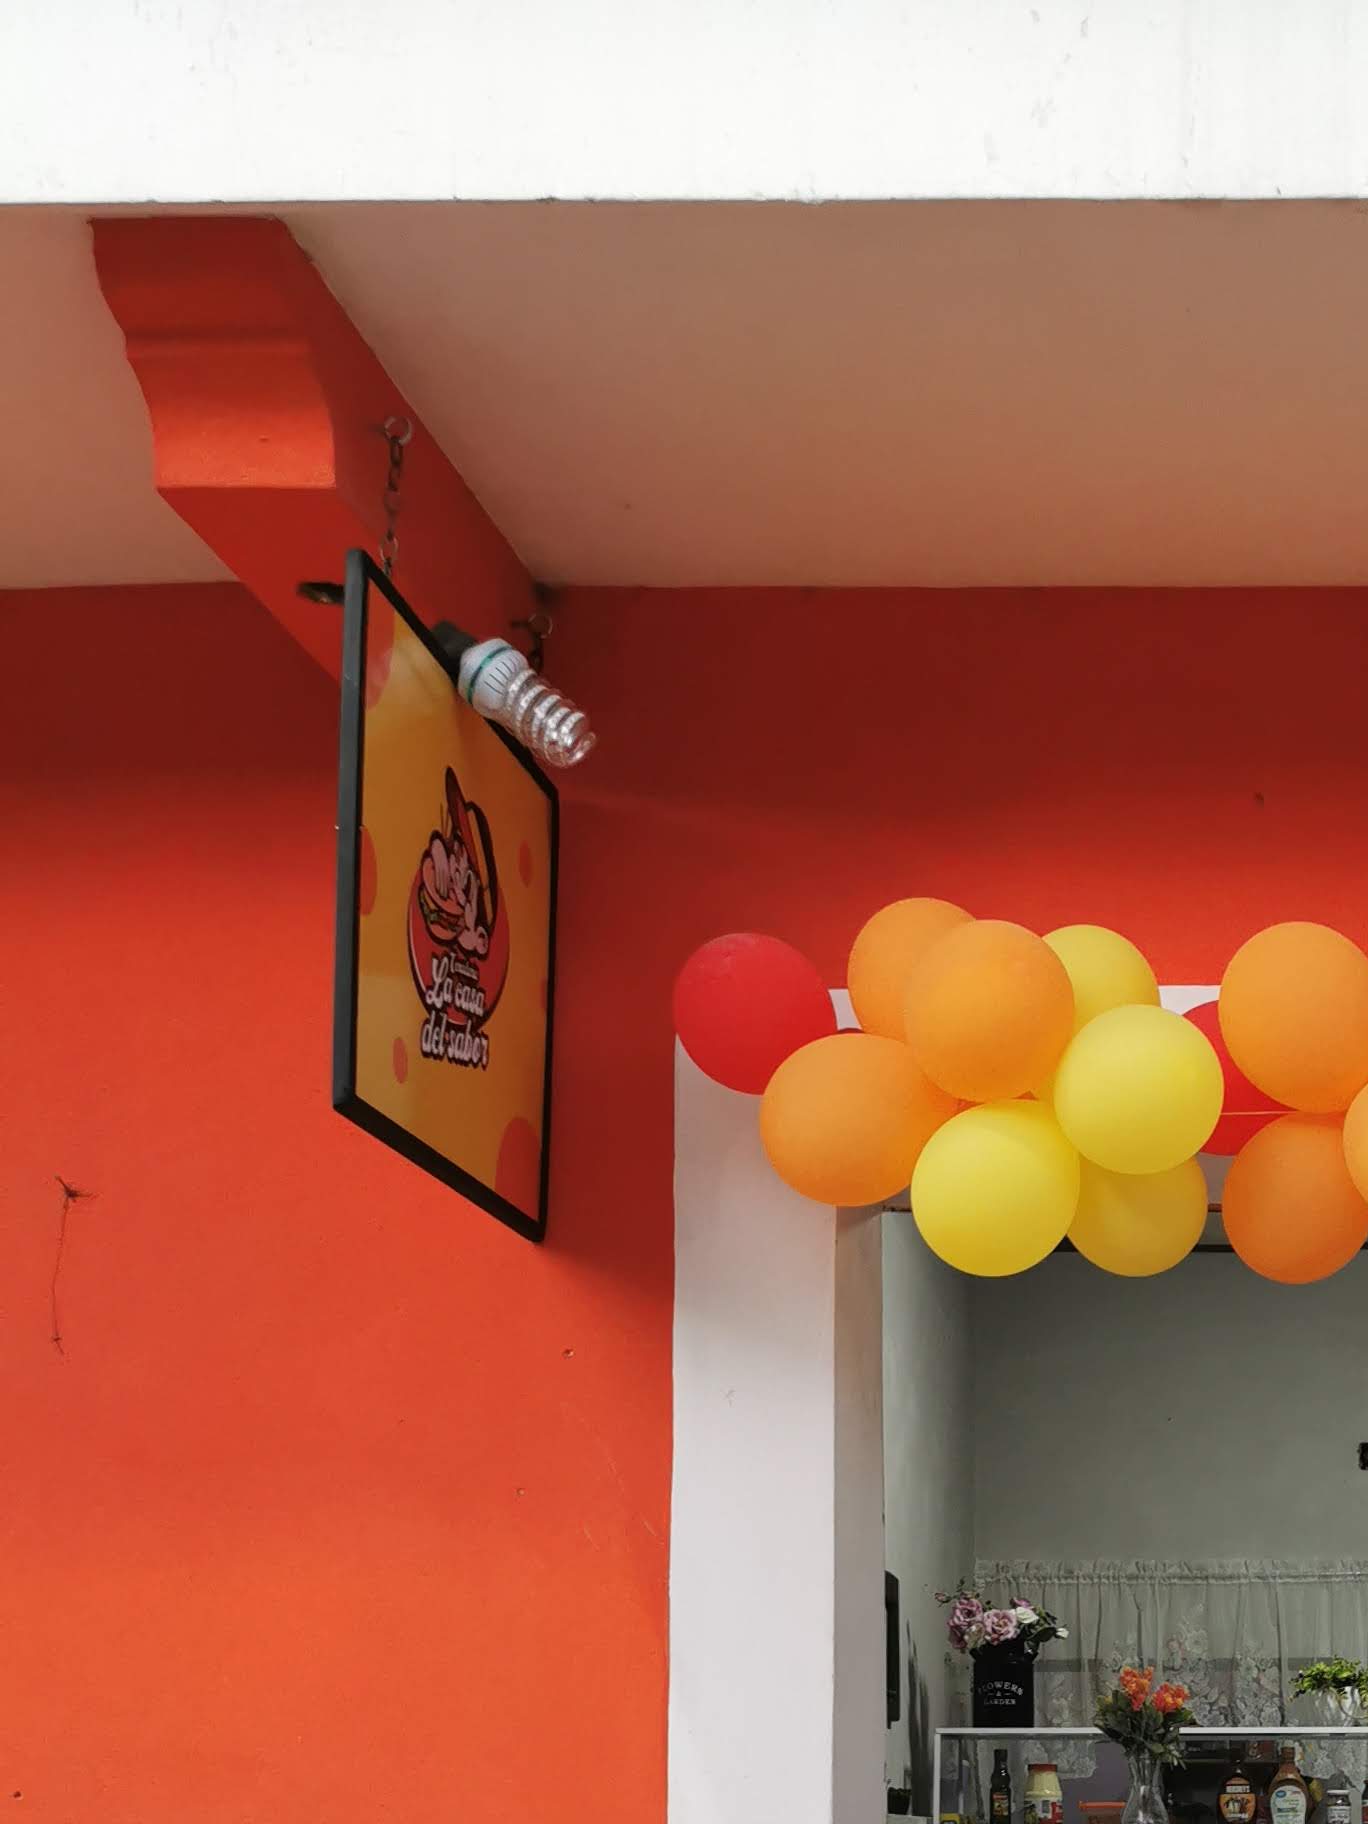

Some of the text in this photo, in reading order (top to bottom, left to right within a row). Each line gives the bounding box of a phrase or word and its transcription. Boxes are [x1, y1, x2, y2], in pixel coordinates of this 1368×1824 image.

[425, 956, 453, 1009] La
[455, 982, 485, 1017] casa
[421, 1010, 488, 1066] del sabor
